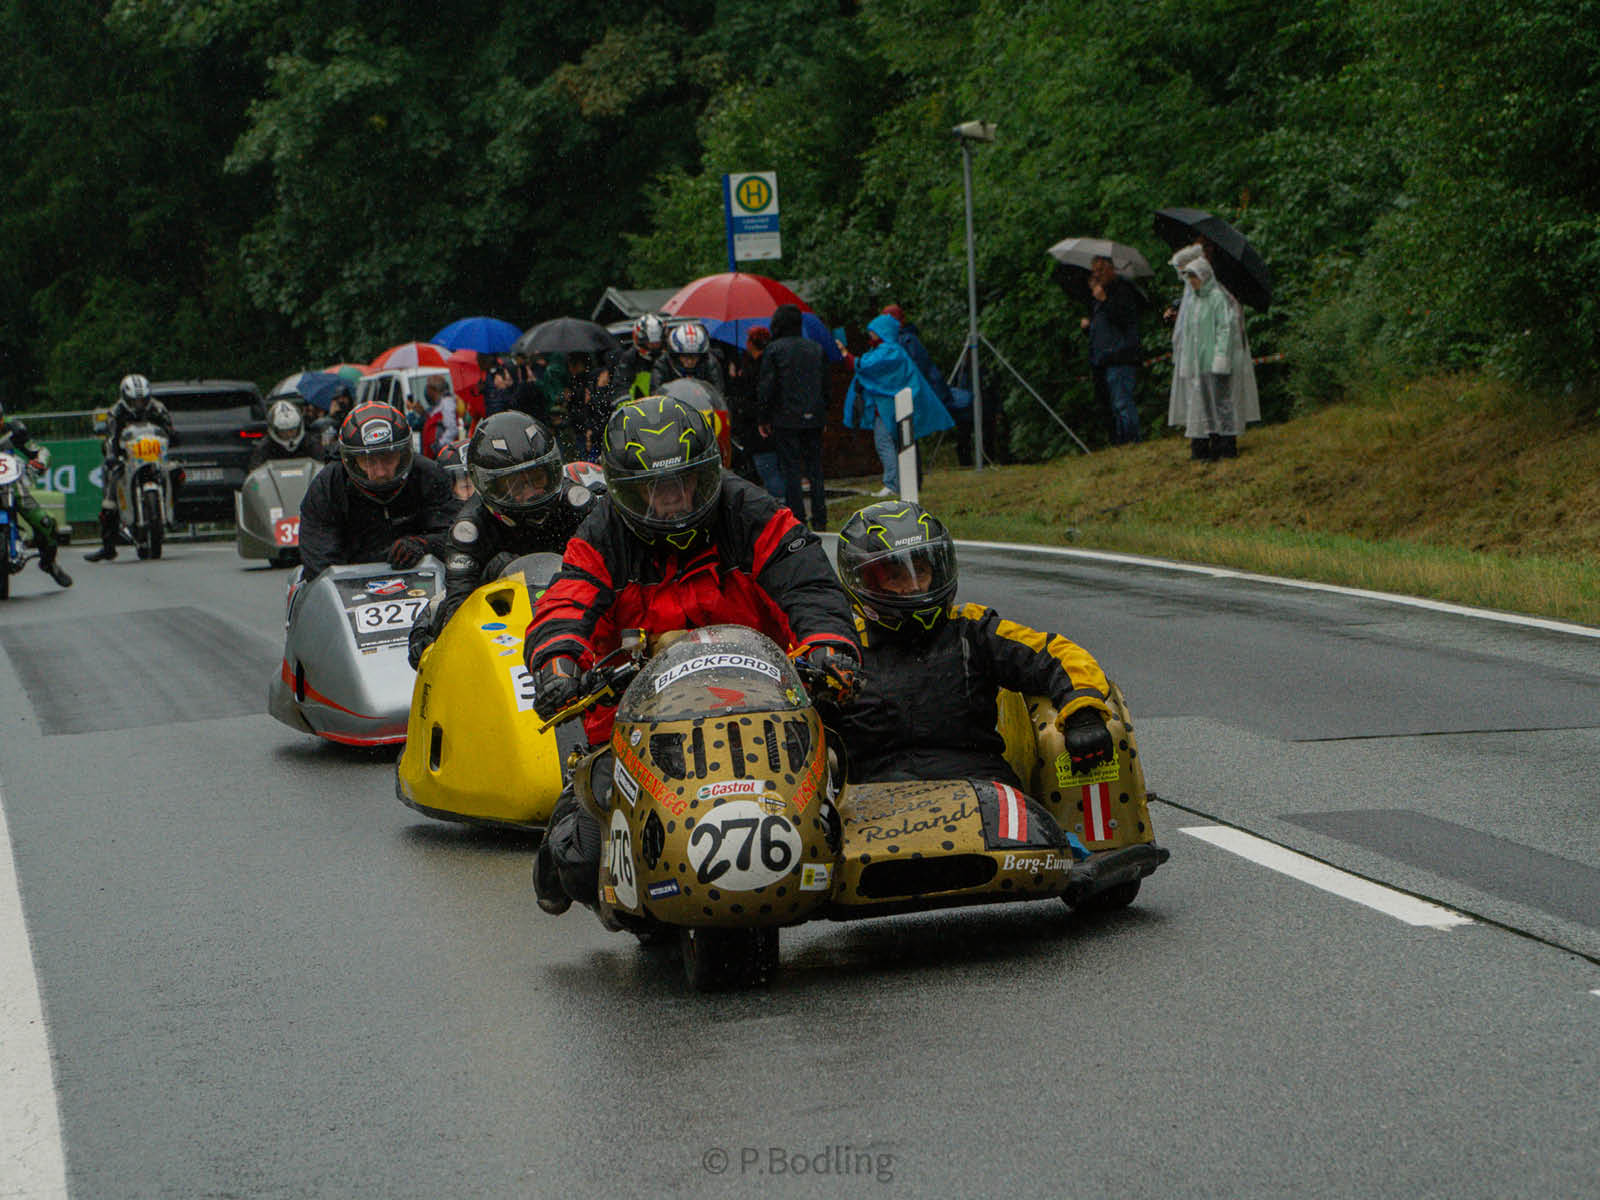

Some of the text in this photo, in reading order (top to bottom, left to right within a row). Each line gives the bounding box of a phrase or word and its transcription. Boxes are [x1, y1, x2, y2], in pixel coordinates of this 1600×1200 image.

[746, 183, 762, 204] H
[894, 535, 922, 547] NOLAN
[364, 601, 421, 626] 327
[658, 655, 780, 689] BLACKFORDS
[711, 782, 756, 796] Castrol
[858, 801, 981, 842] Roland
[691, 815, 792, 885] 276
